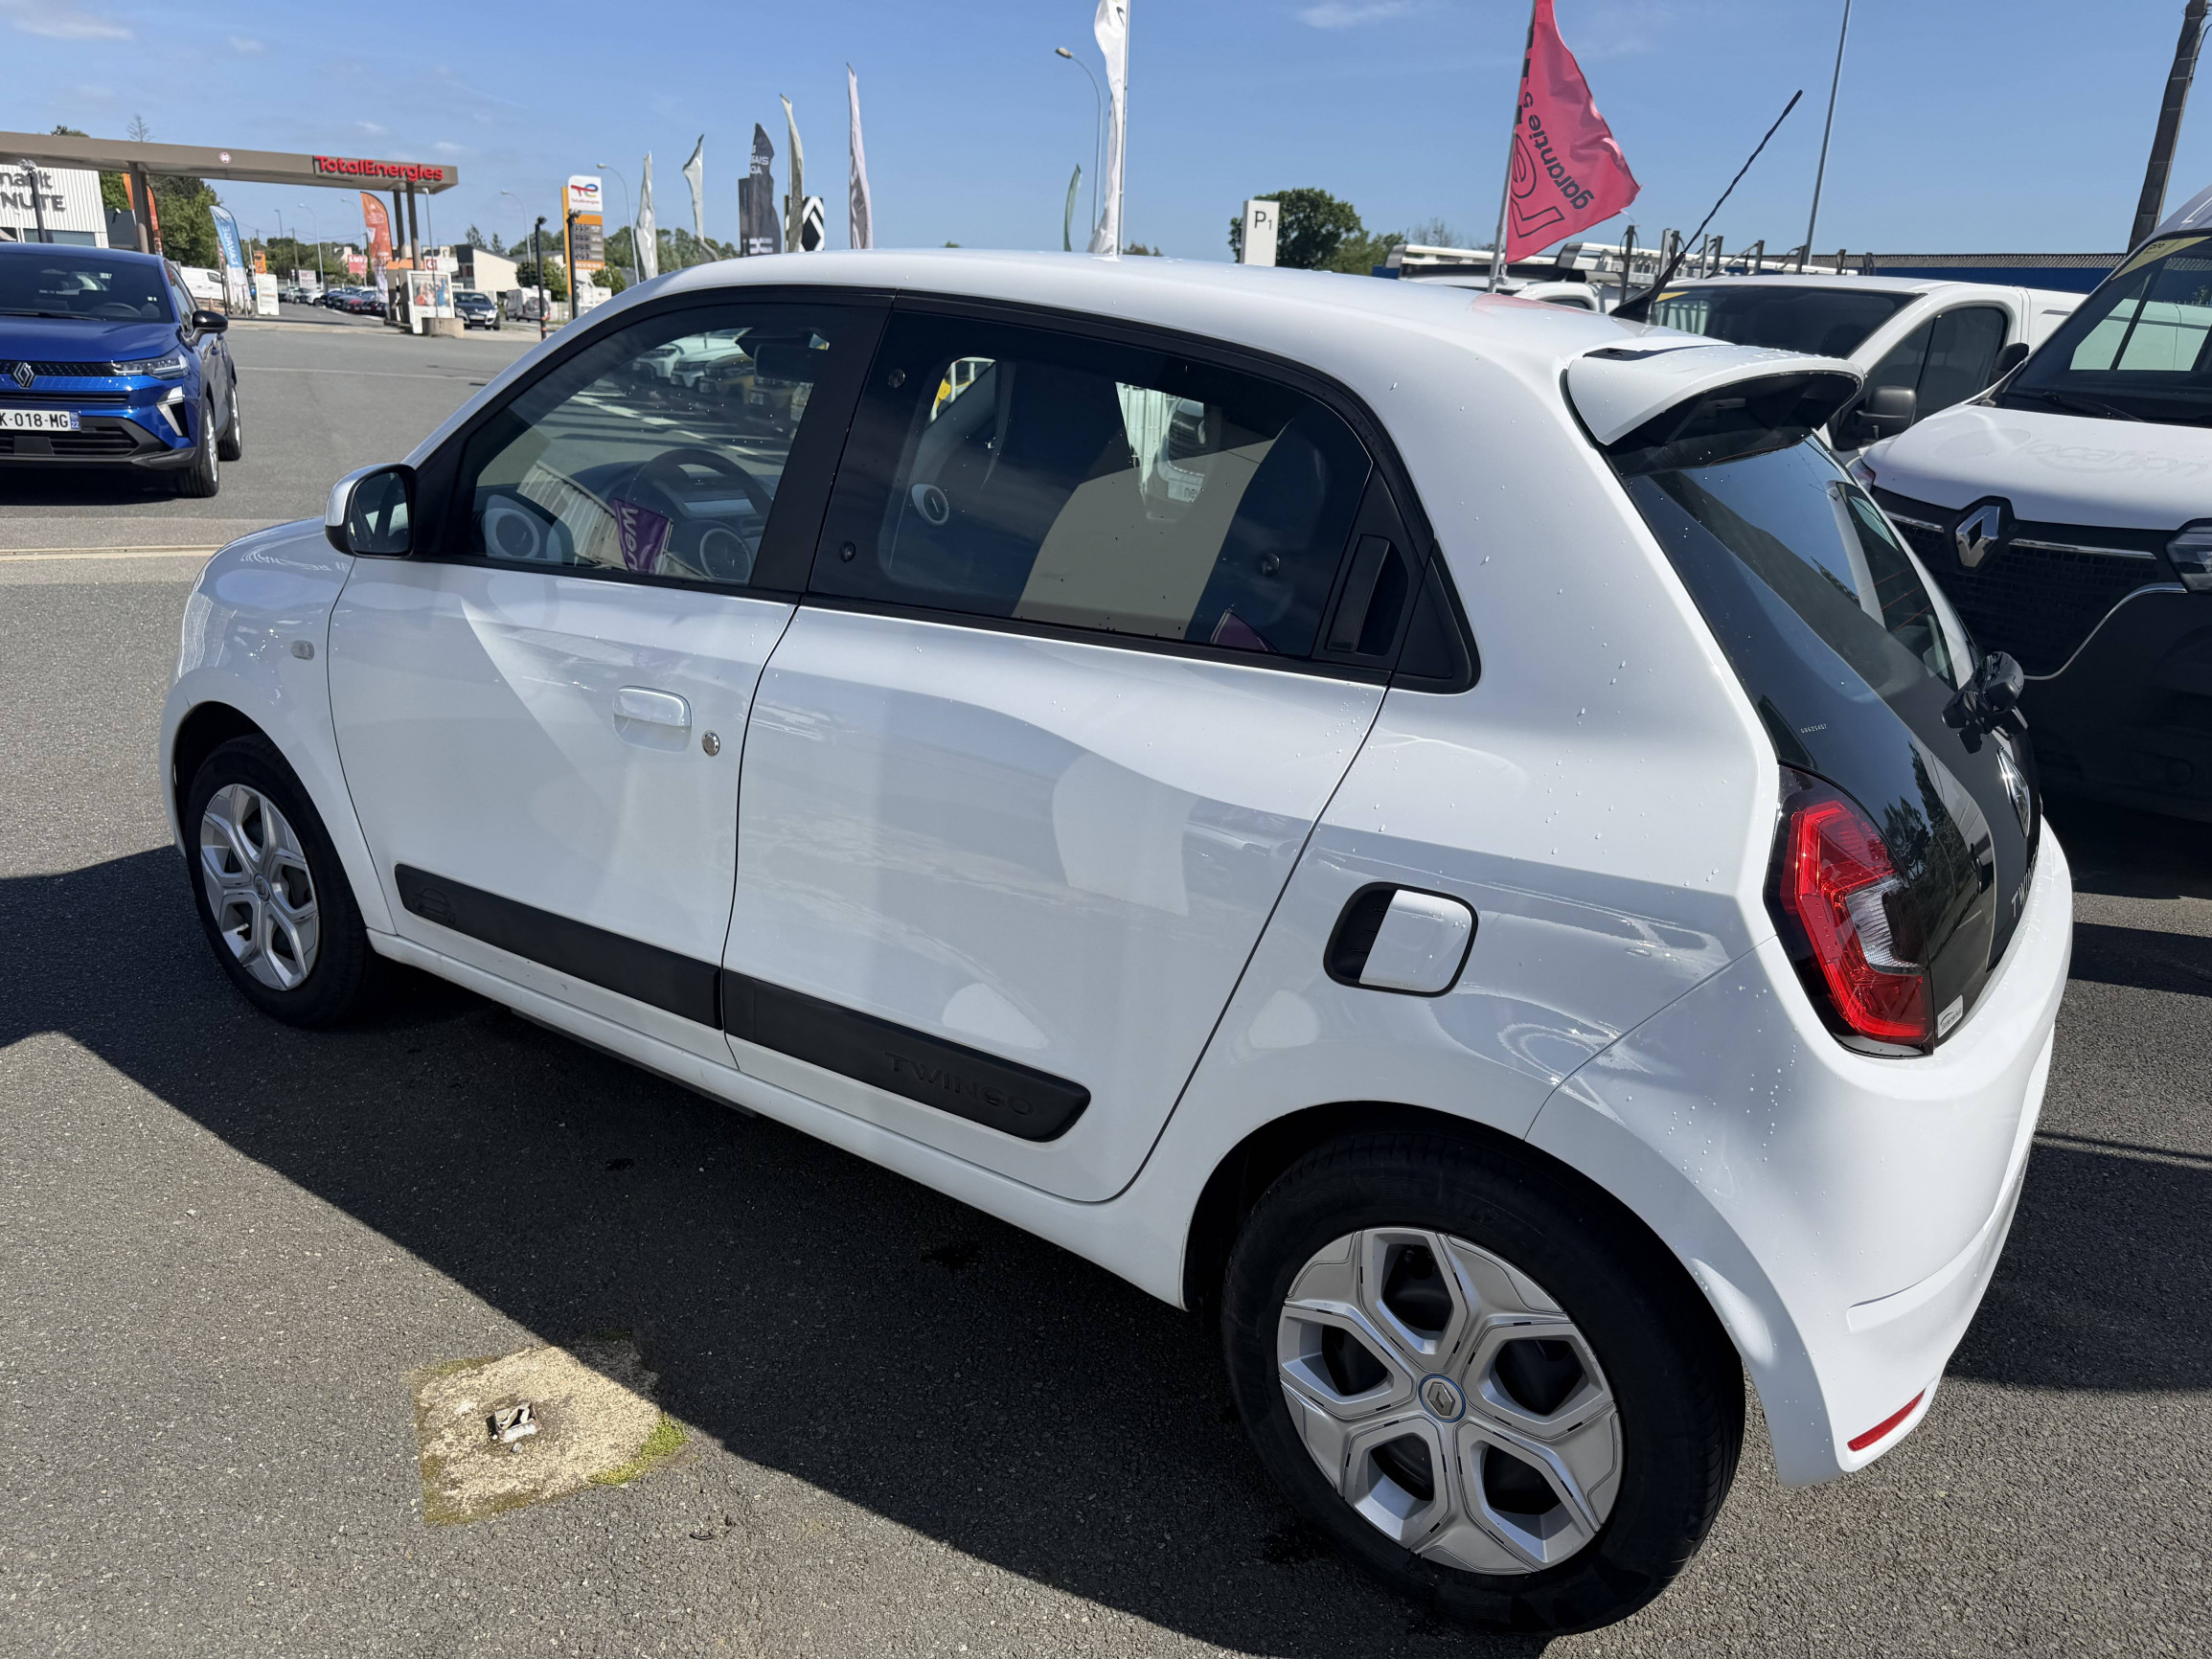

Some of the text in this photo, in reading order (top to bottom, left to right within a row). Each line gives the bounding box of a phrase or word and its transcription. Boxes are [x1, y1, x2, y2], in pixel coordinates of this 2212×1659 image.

[314, 154, 444, 182] TotalEnergies
[1528, 114, 1594, 209] garantie
[221, 225, 239, 264] LAVAGE
[883, 1051, 1035, 1116] TWINGO
